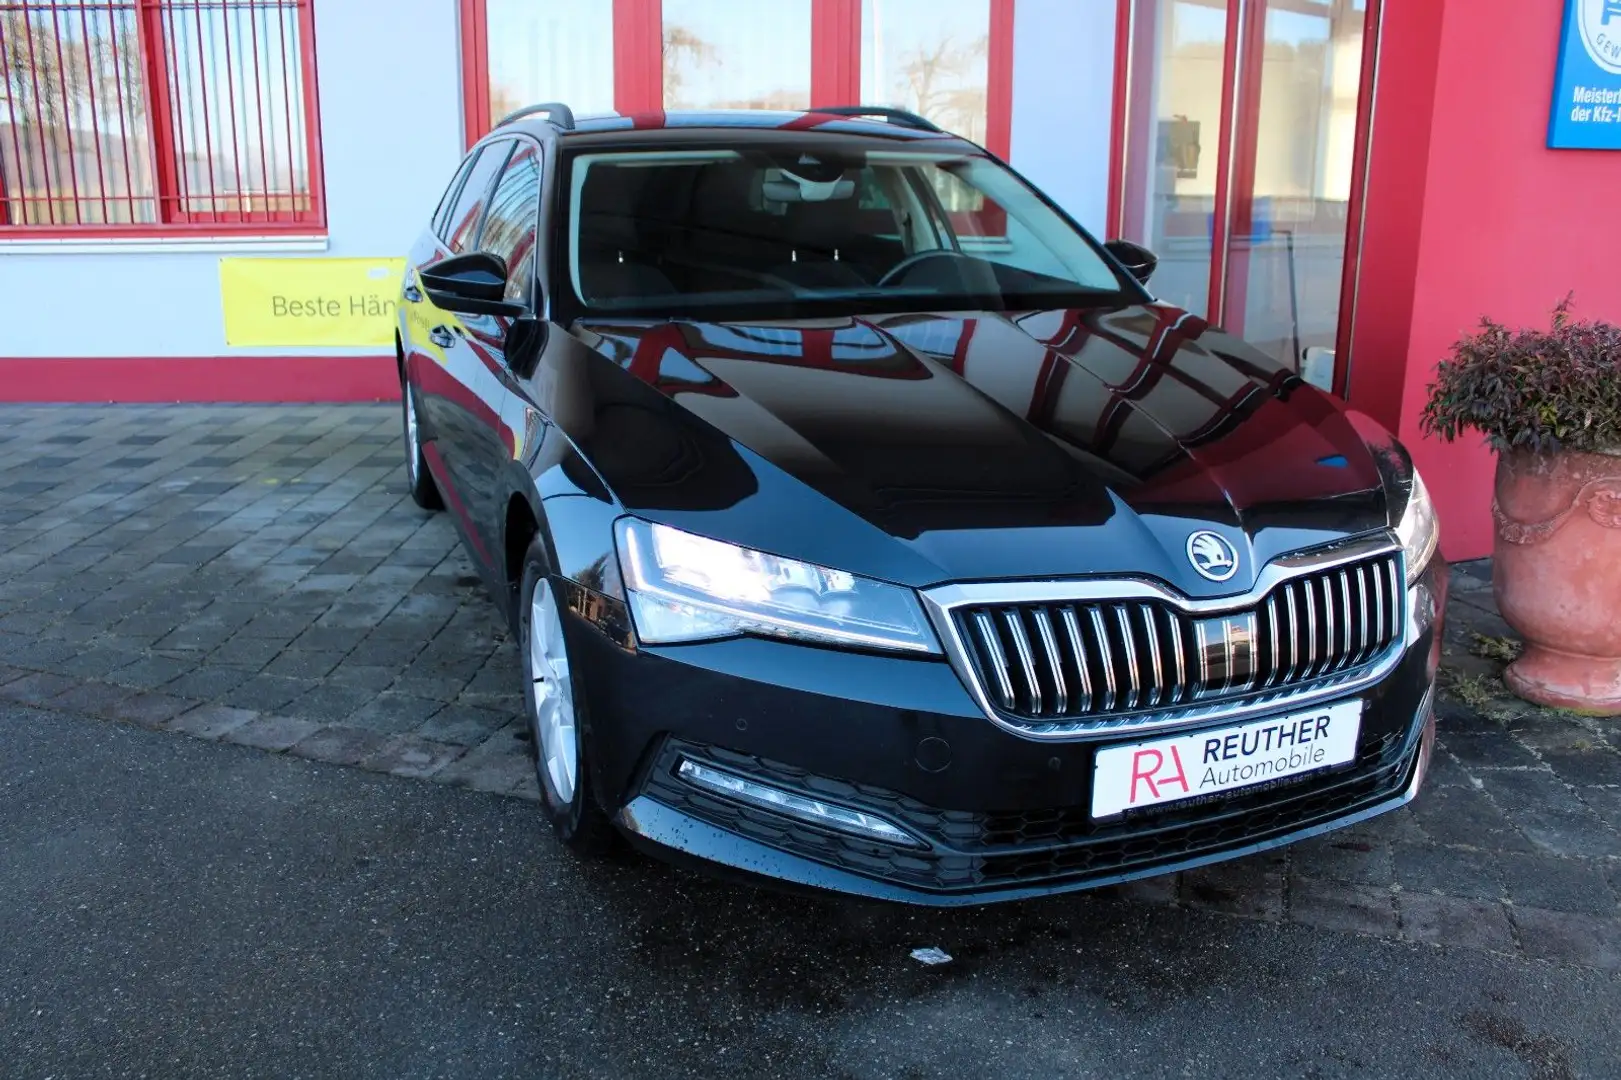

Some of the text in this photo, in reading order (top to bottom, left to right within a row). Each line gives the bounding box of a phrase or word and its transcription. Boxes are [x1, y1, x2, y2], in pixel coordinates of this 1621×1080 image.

[1571, 105, 1591, 122] der
[272, 295, 341, 317] Beste
[1203, 715, 1331, 764] REUTHER
[1199, 746, 1326, 789] Automobile
